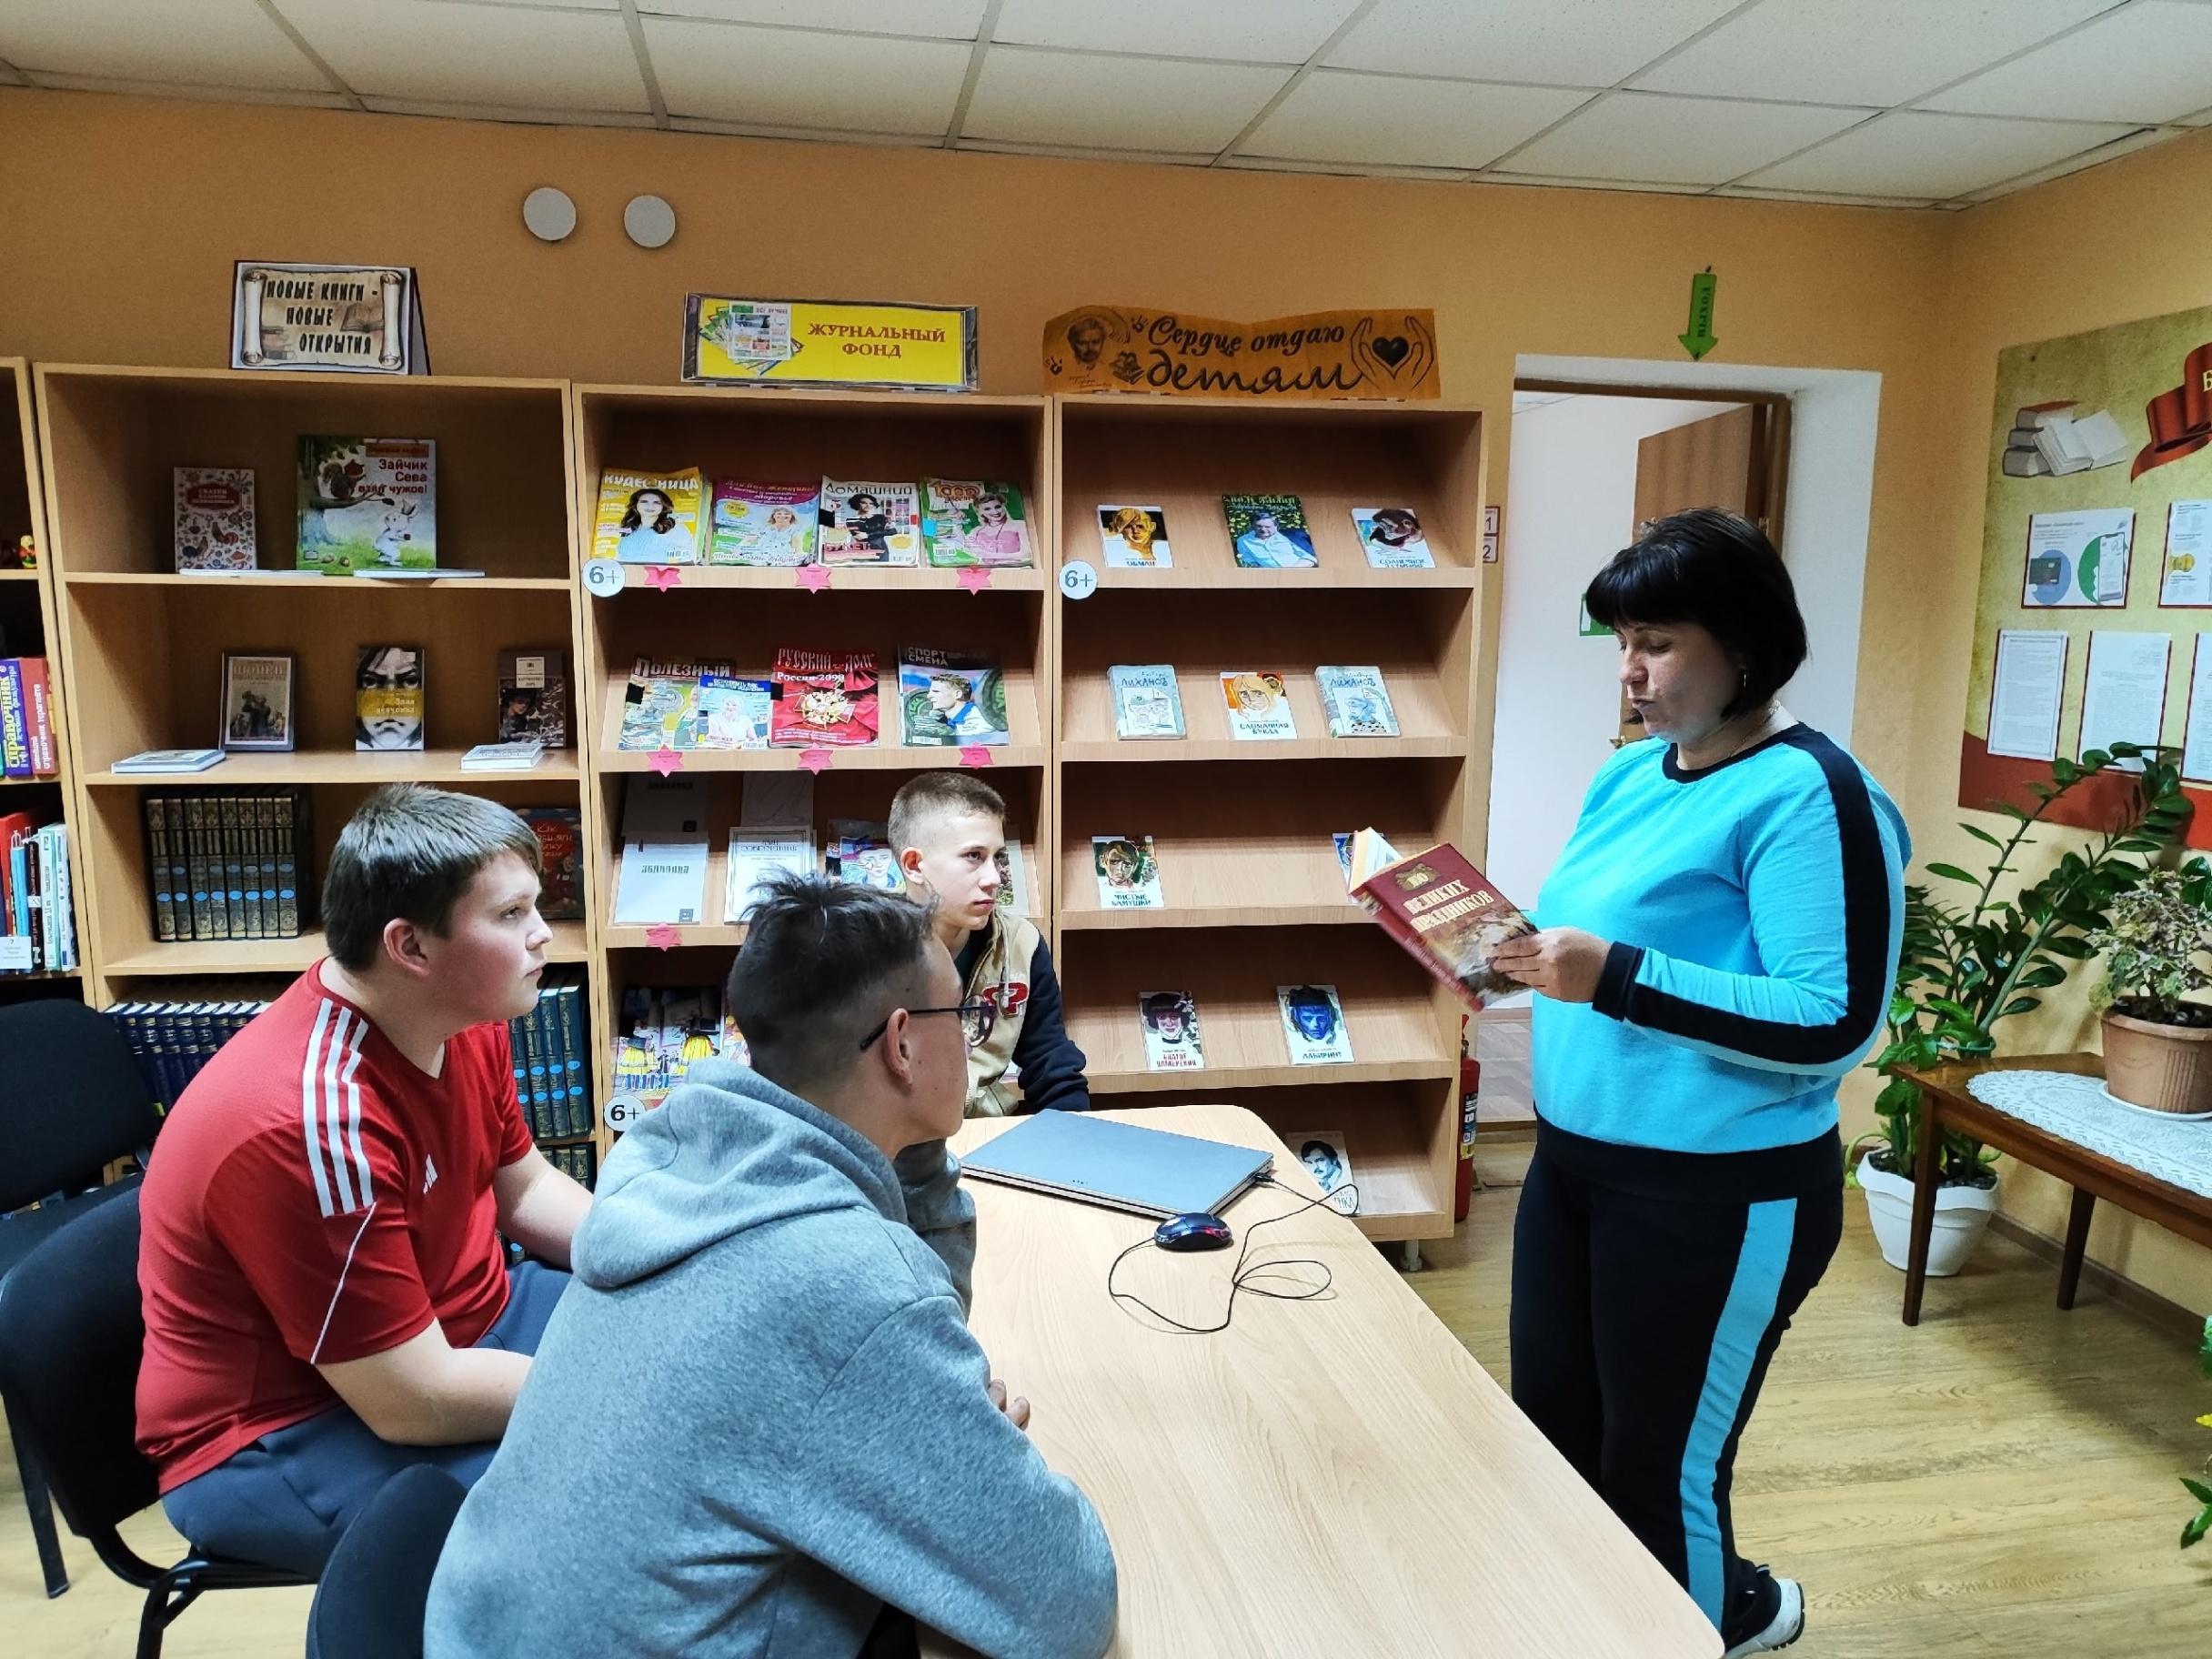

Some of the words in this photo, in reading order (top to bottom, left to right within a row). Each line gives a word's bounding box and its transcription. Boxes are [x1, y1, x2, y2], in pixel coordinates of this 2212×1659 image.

[266, 281, 314, 300] НОВЫЕ
[320, 282, 364, 301] КНИГИ
[287, 307, 333, 326] НОВЫЕ
[808, 323, 946, 343] ЖУРНАЛЬНЫЙ
[1148, 315, 1242, 357] Сердце
[1251, 324, 1345, 356] отдаю
[299, 333, 372, 355] ОТКРЫТИЯ
[842, 343, 901, 359] ФОНД
[1145, 348, 1365, 393] детям
[378, 458, 428, 470] Зайчик
[395, 471, 427, 482] Сева
[389, 485, 427, 496] чужое!
[1485, 516, 1493, 530] 1
[589, 566, 619, 585] 6+
[1064, 569, 1093, 588] 6+
[909, 654, 949, 666] СМЕНА
[1302, 1051, 1343, 1060] ЛАБИРИНТ
[610, 1104, 640, 1121] 6+
